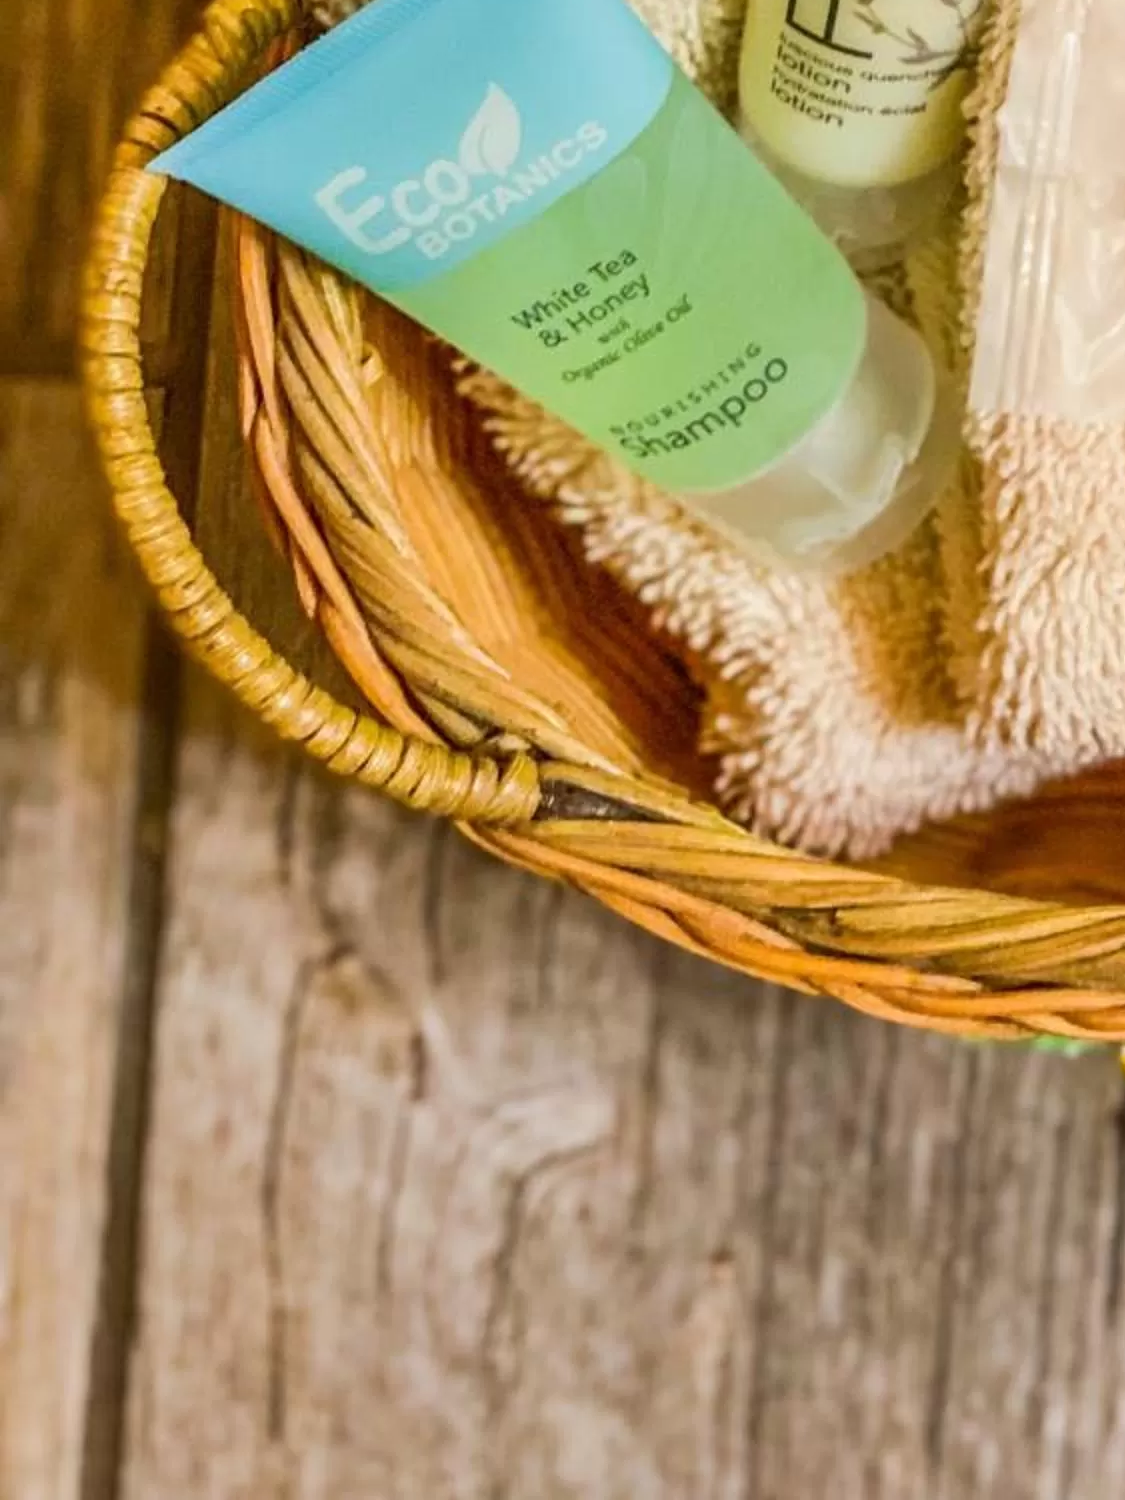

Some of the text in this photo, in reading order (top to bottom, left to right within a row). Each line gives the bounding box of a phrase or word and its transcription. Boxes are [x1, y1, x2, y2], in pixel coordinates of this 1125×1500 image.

[771, 76, 844, 128] lotion
[777, 43, 851, 94] lotion
[416, 119, 609, 260] BOTANICS
[510, 248, 639, 330] White Tea
[538, 272, 650, 348] & Honey
[608, 341, 763, 436] NOURISHING
[619, 357, 788, 458] Shampoo
